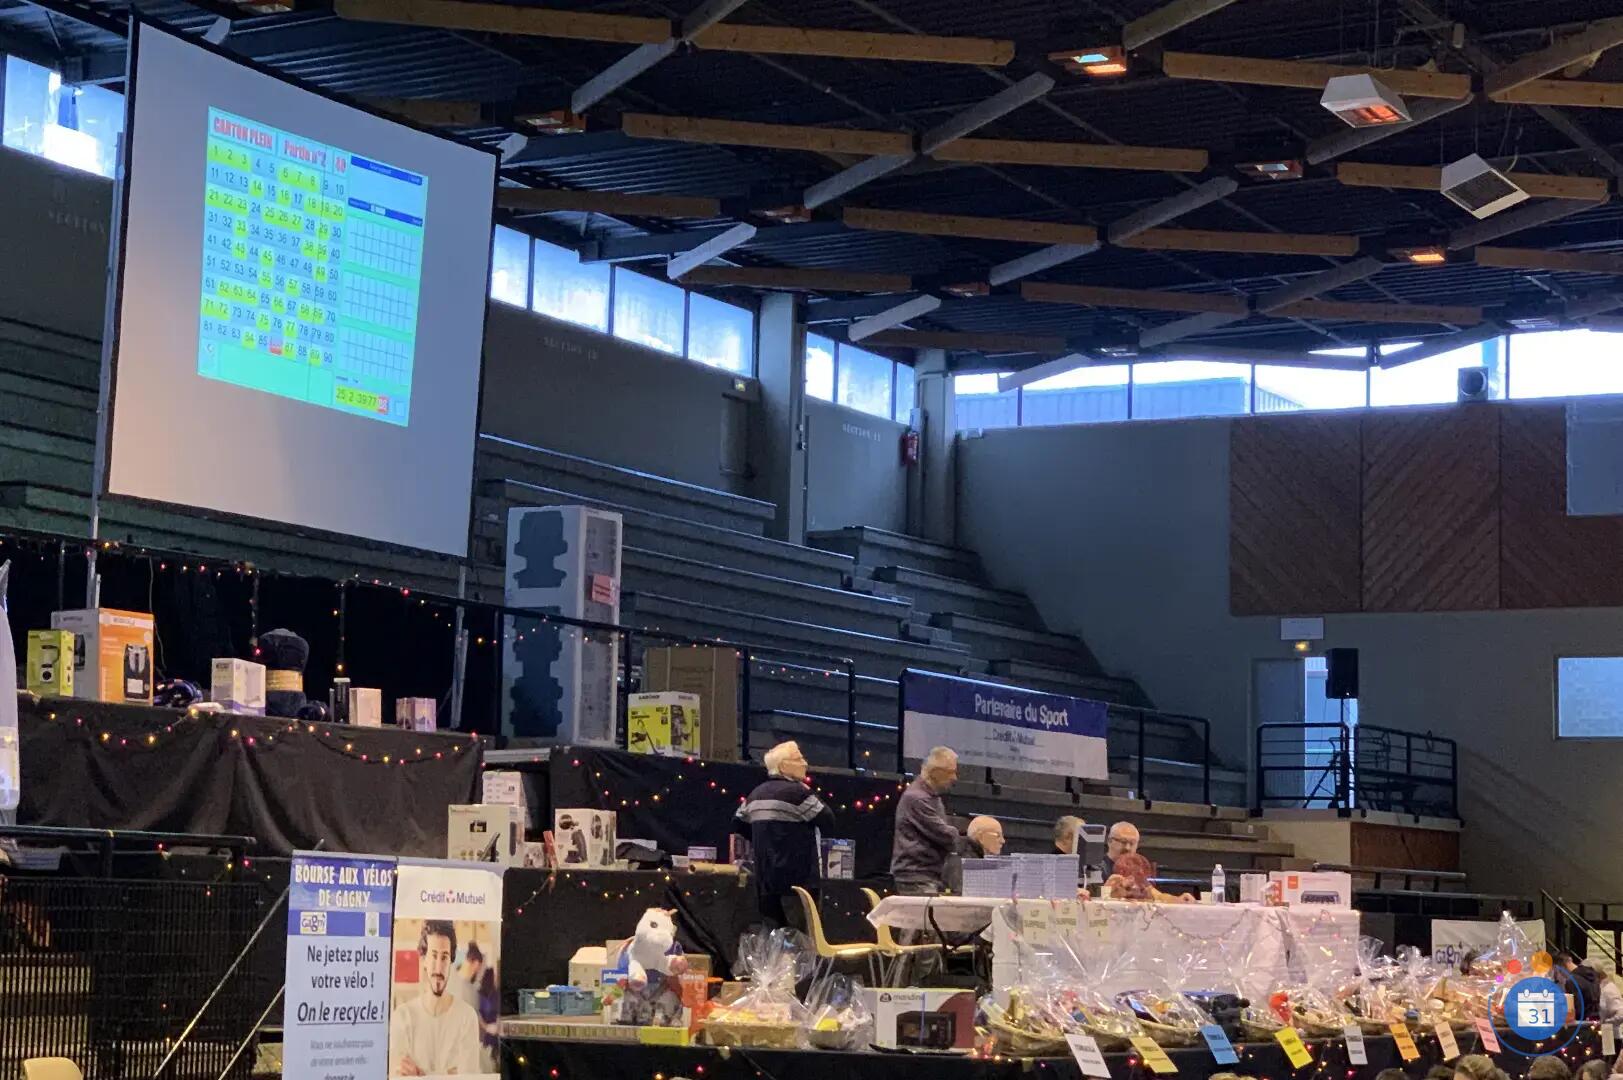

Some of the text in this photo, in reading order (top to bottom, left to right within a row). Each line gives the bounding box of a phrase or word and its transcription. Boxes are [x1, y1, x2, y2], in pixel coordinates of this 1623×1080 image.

[212, 168, 219, 178] 11
[225, 172, 234, 183] 12
[239, 176, 248, 187] 13
[253, 181, 262, 191] 14
[267, 185, 276, 196] 15
[281, 189, 289, 200] 16
[294, 193, 303, 204] 17
[334, 206, 343, 216] 20
[335, 184, 345, 194] 10
[209, 190, 219, 201] 21
[223, 194, 233, 205] 22
[237, 199, 247, 209] 23
[292, 215, 302, 226] 27
[305, 219, 315, 230] 28
[319, 223, 328, 234] 29
[332, 227, 342, 238] 30
[208, 213, 218, 223] 31
[222, 217, 232, 227] 32
[250, 225, 259, 235] 34
[264, 229, 273, 240] 35
[277, 233, 287, 244] 36
[291, 237, 300, 248] 37
[331, 249, 340, 259] 40
[207, 235, 217, 245] 41
[221, 239, 231, 249] 42
[249, 247, 258, 257] 44
[262, 250, 272, 261] 45
[289, 258, 299, 269] 47
[303, 262, 312, 273] 48
[329, 270, 339, 280] 50
[206, 256, 216, 267] 51
[220, 260, 230, 271] 52
[234, 264, 244, 275] 53
[248, 268, 257, 279] 54
[275, 276, 284, 286] 56
[301, 283, 311, 294] 58
[314, 287, 324, 298] 59
[206, 278, 215, 289] 61
[260, 293, 270, 304] 65
[287, 300, 296, 311] 67
[326, 311, 336, 322] 70
[205, 299, 214, 310] 71
[218, 303, 228, 314] 72
[232, 307, 242, 317] 73
[246, 310, 255, 321] 74
[259, 314, 268, 325] 75
[272, 318, 282, 328] 76
[285, 321, 295, 332] 77
[299, 325, 308, 335] 78
[312, 328, 321, 339] 79
[323, 352, 333, 363] 90
[974, 692, 1069, 729] Partenaire du Sport
[295, 864, 393, 886] BOURSE AUX VÉLOS
[318, 888, 371, 909] DE GAGNY
[420, 890, 486, 905] Crédit Mutuel
[307, 946, 379, 967] Ne jetez plus
[311, 972, 374, 989] votre vélo !
[298, 1000, 385, 1026] On le recycle !
